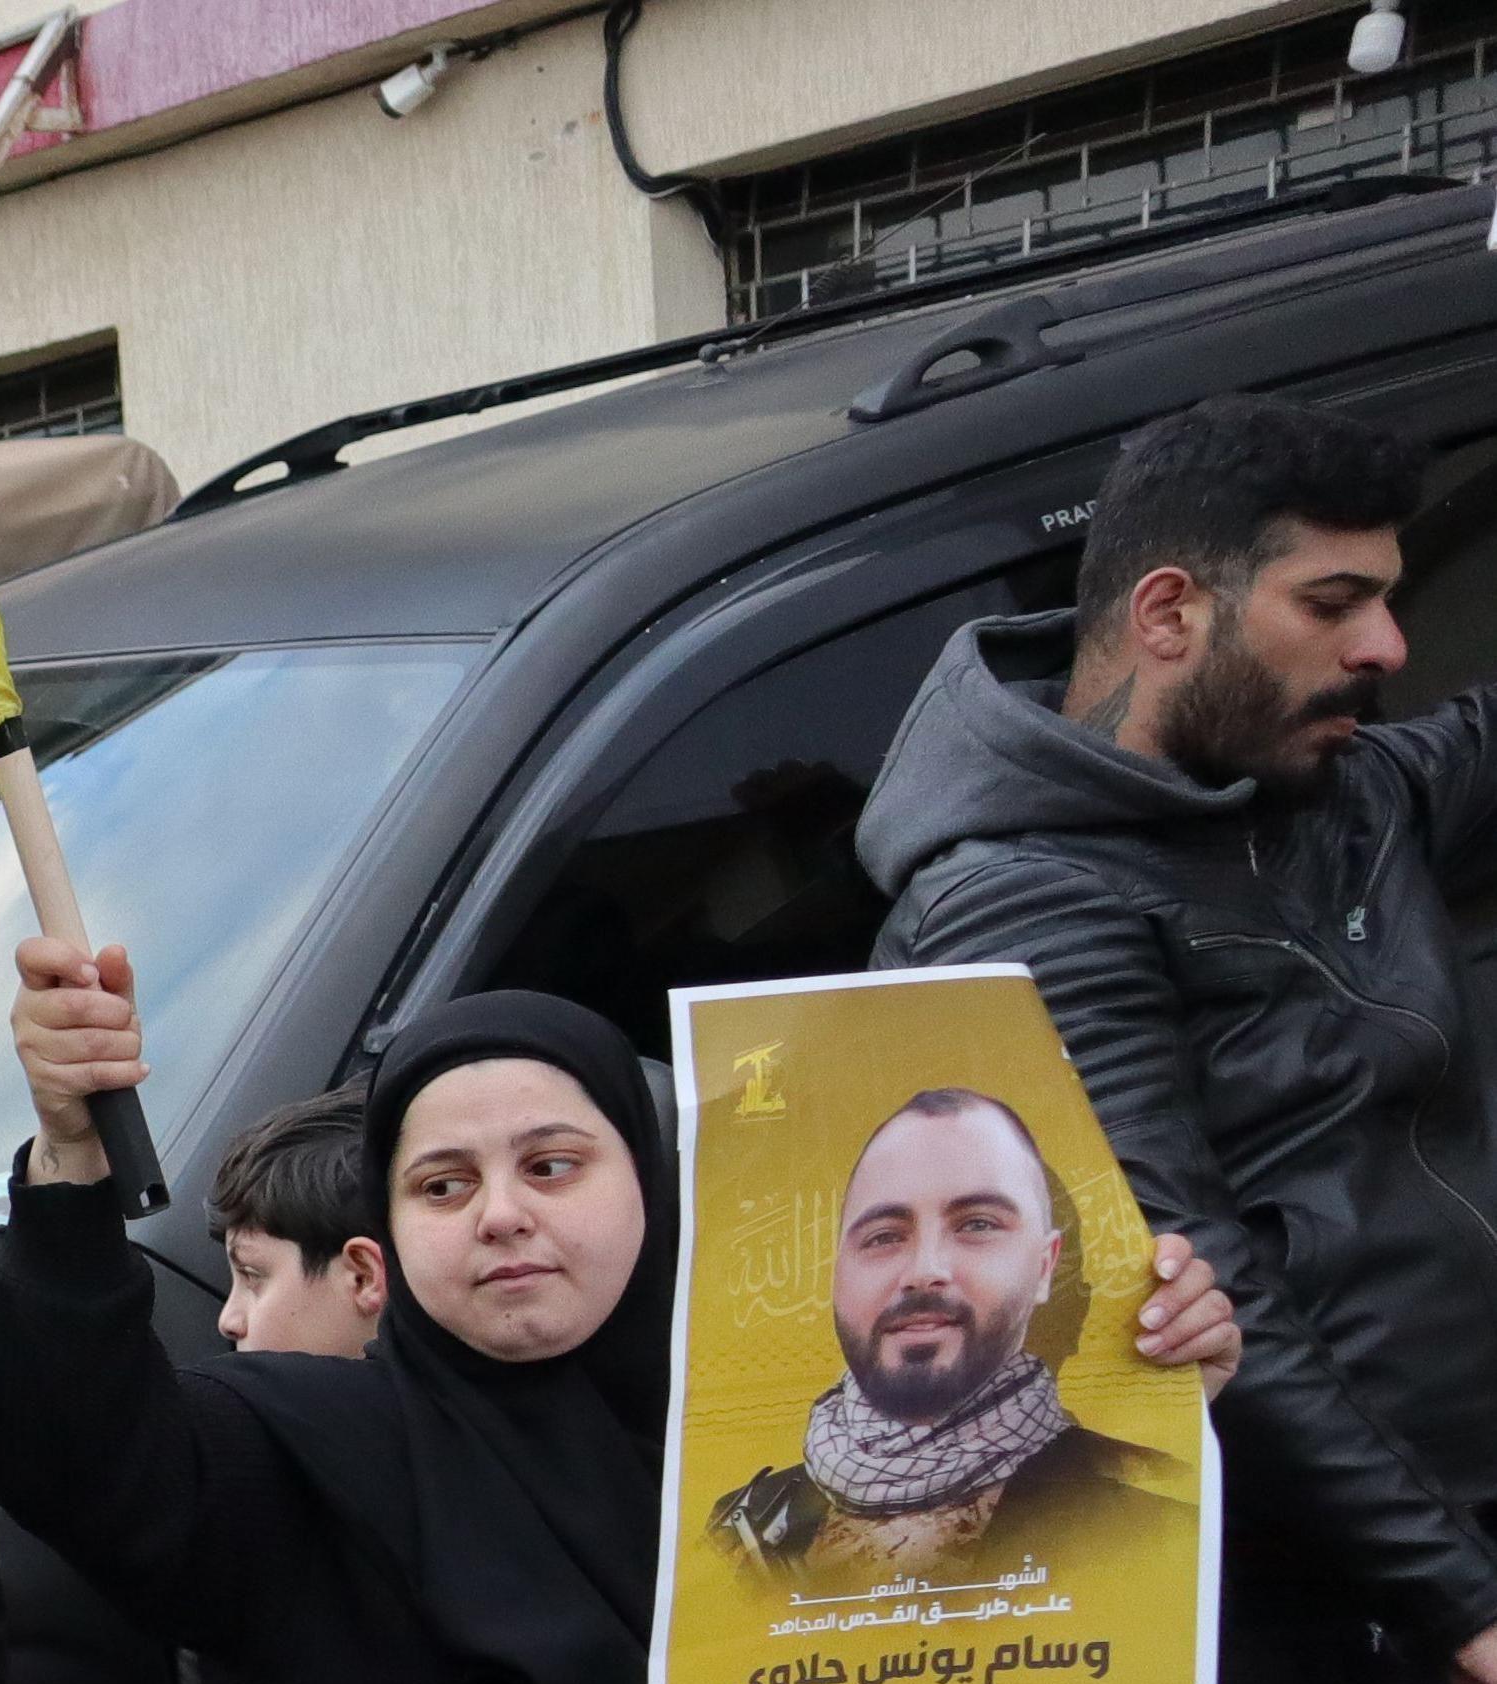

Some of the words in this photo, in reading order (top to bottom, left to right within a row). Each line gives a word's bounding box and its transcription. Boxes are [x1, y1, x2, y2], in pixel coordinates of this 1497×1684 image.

[1041, 500, 1097, 532] PRA
[769, 1613, 837, 1636] المجاهد
[838, 1604, 918, 1632] القدس
[920, 1599, 1009, 1626] طريق
